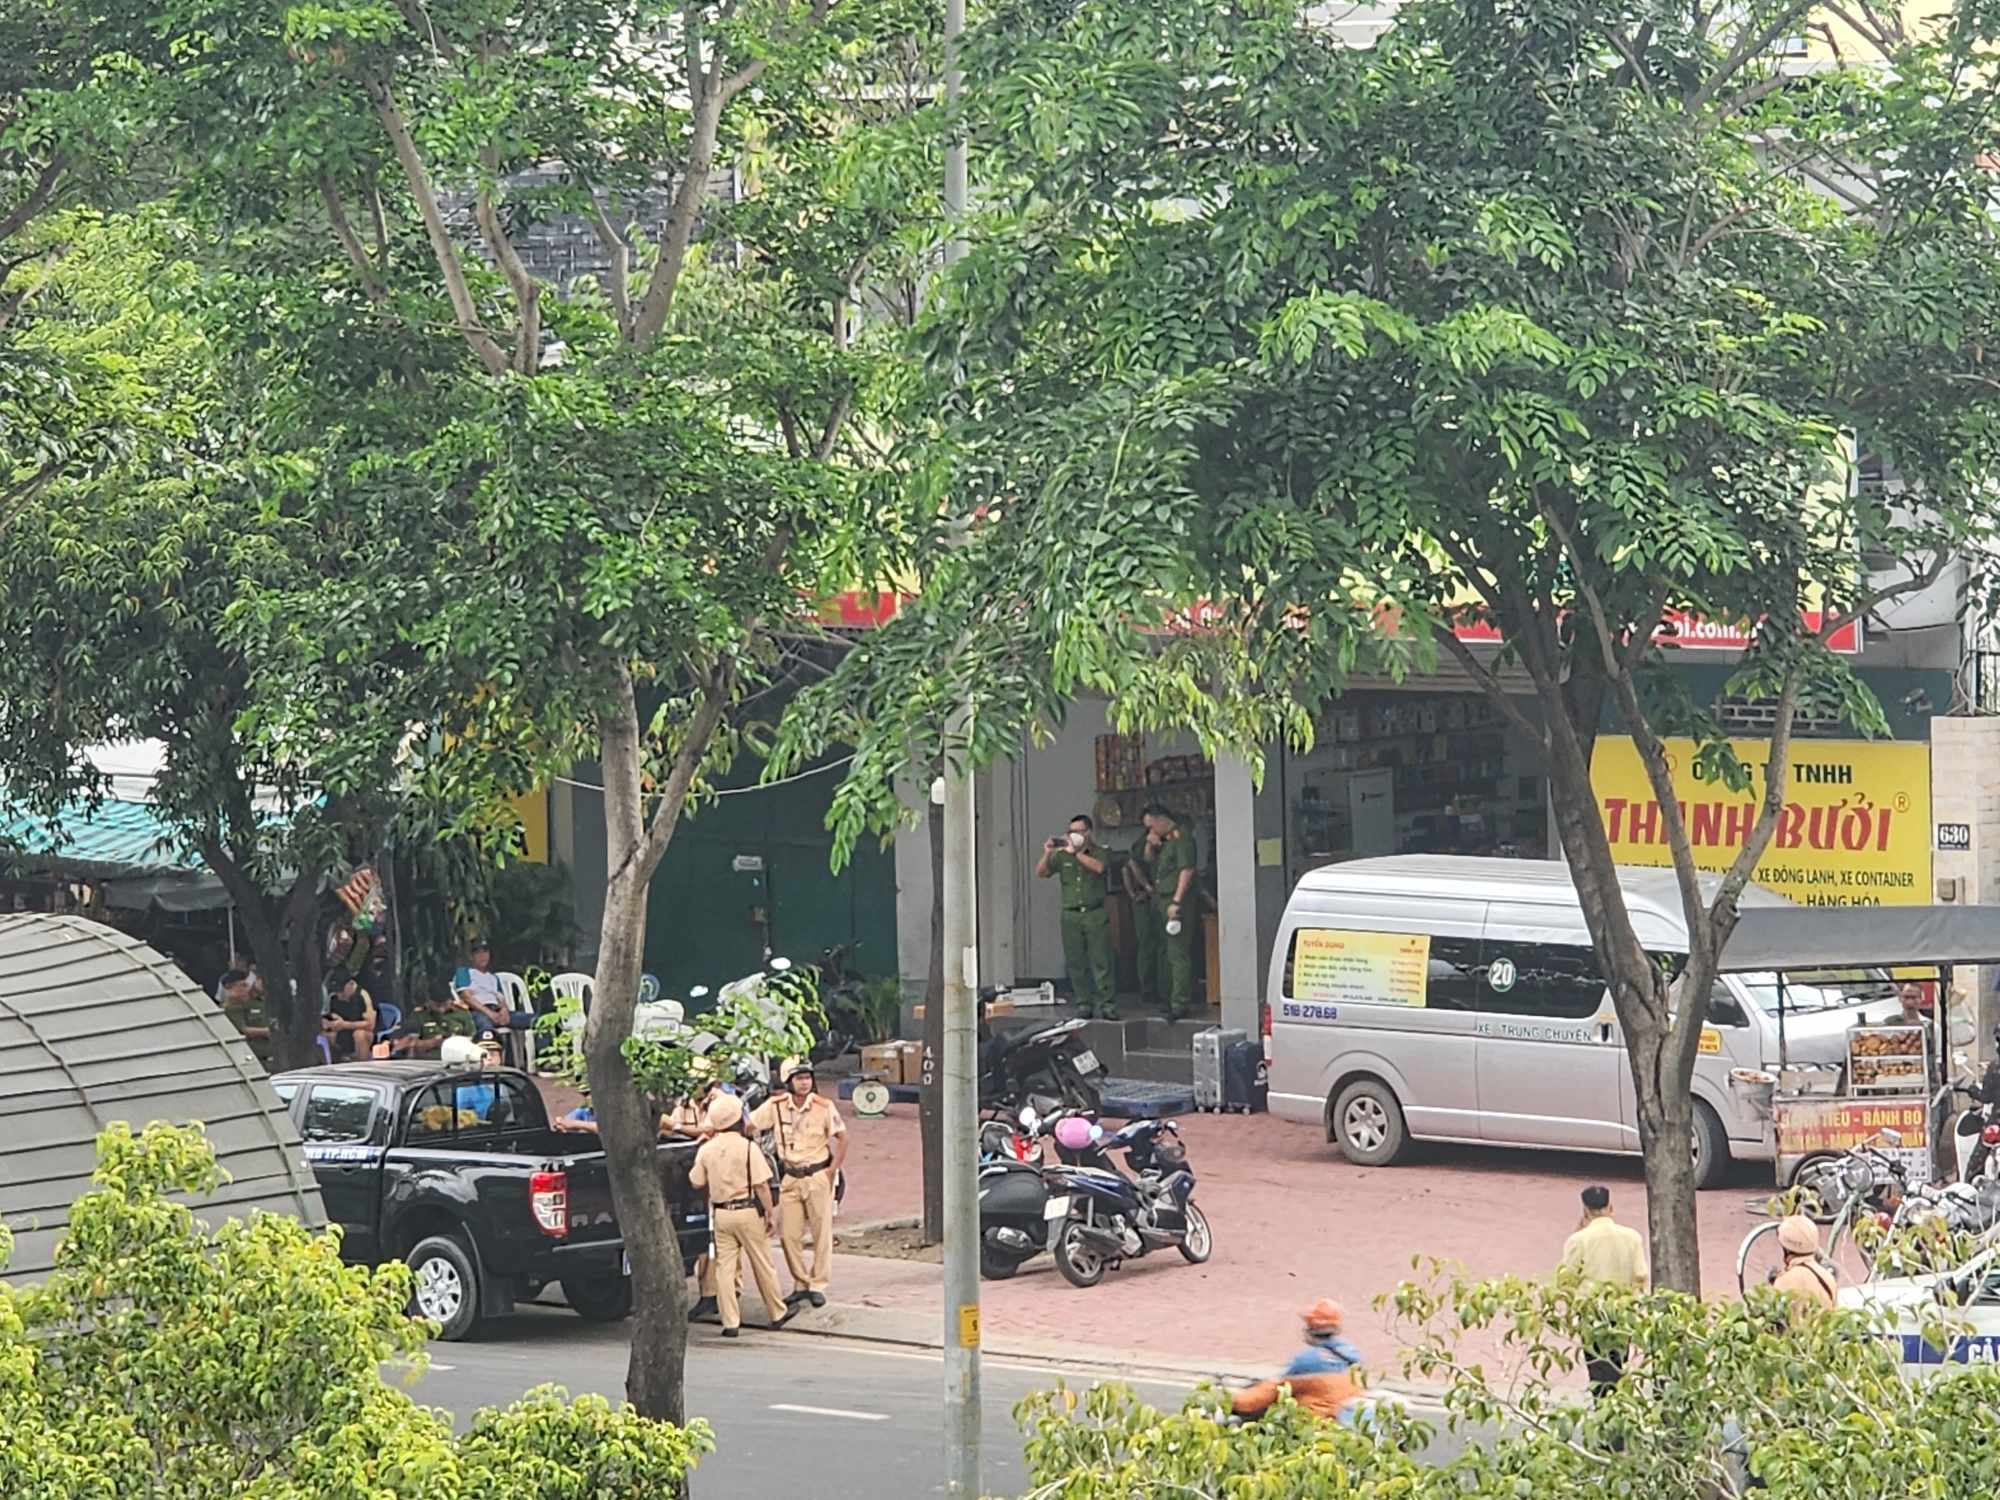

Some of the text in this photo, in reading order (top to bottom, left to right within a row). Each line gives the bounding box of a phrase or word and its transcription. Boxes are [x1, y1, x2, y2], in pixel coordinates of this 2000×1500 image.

[1793, 763, 1852, 784] TNHH
[1775, 791, 1892, 851] BƯỞI
[1940, 825, 1968, 844] 630
[1758, 868, 1770, 883] XE
[1840, 870, 1853, 886] XE
[1855, 871, 1914, 887] CONTAINER
[1491, 962, 1512, 985] 20
[1478, 1023, 1490, 1034] XE
[1502, 1024, 1540, 1038] TRUNG
[1863, 1107, 1900, 1126] BÁNH
